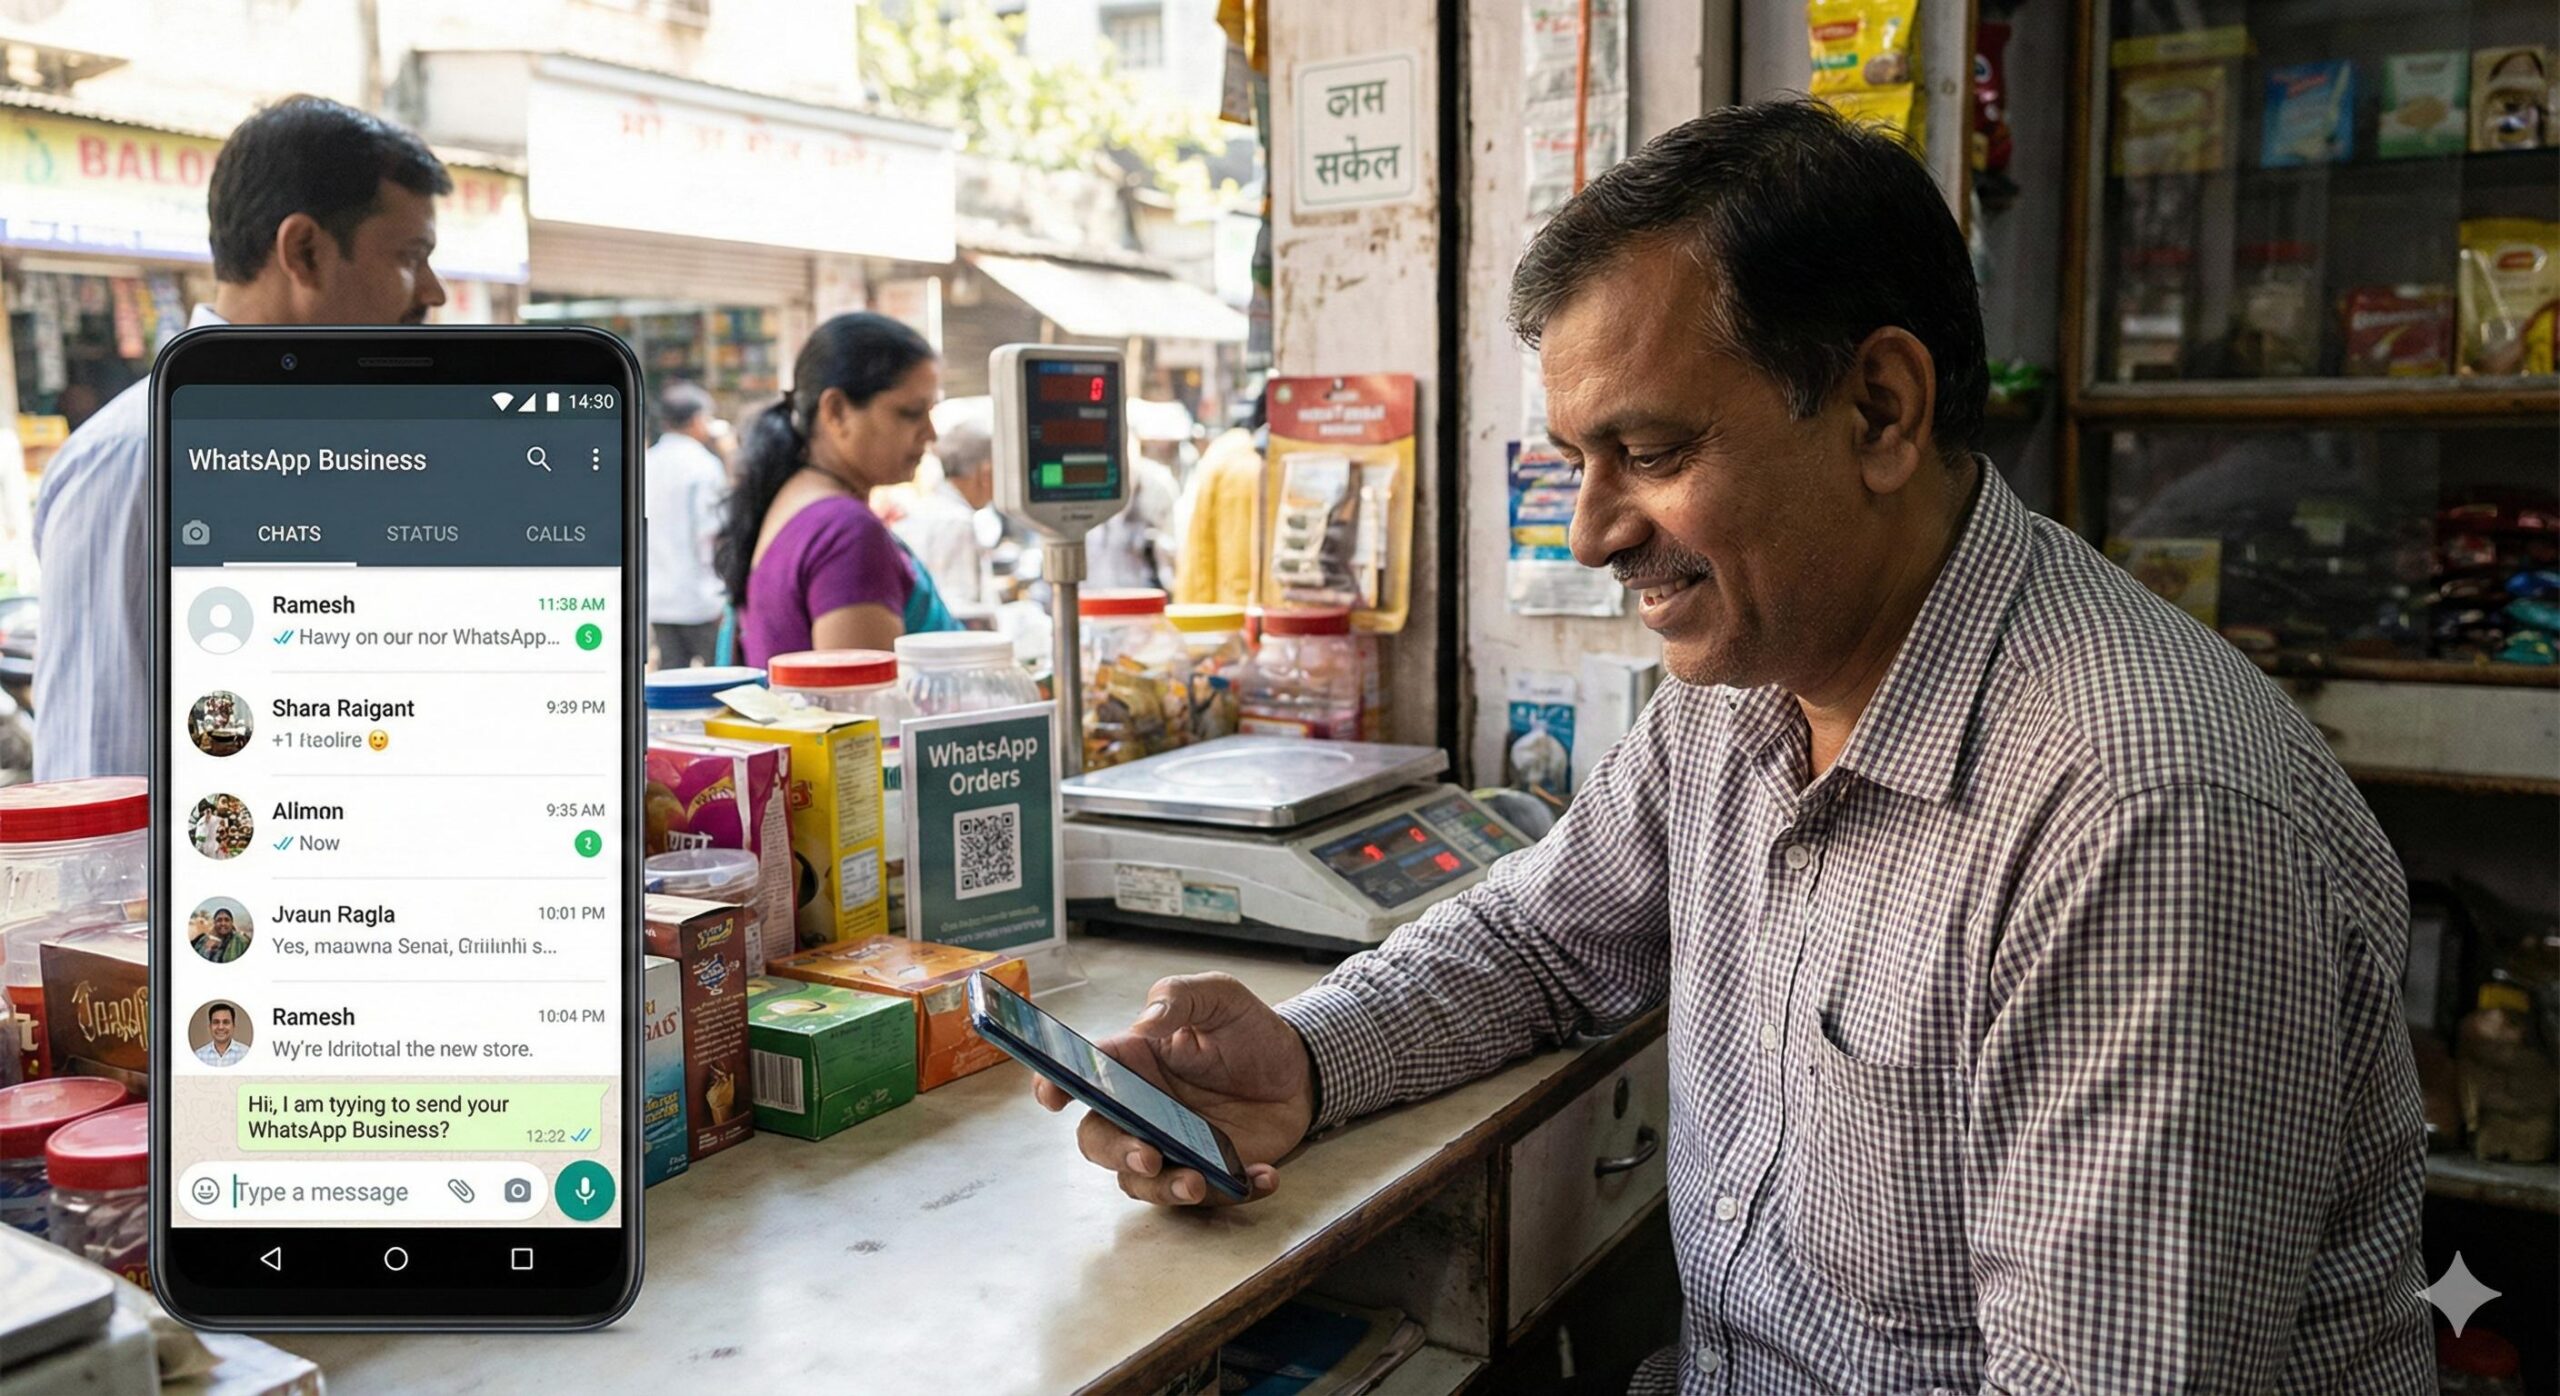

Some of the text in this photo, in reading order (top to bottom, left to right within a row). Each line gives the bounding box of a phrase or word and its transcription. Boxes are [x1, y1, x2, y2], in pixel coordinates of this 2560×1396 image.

[569, 394, 613, 409] 14:30
[189, 448, 426, 475] WhatsApp Business
[259, 526, 321, 541] CHATS
[387, 526, 458, 541] STATUS
[527, 526, 585, 541] CALLS
[273, 595, 354, 613] Ramesh
[539, 598, 604, 611] 11:38 AM
[300, 628, 559, 649] Hawy on our nor WhatsApp...
[273, 699, 414, 721] Shara Raigant
[547, 701, 605, 714] 9:39 PM
[272, 732, 292, 747] +1
[929, 735, 1038, 769] WhatsApp
[949, 769, 1022, 797] Orders
[272, 802, 343, 819] Alimon
[547, 803, 605, 817] 9:35 AM
[300, 835, 340, 851] Now
[272, 905, 395, 927] Jvaun Ragla
[539, 907, 604, 920] 10:01 PM
[272, 938, 309, 956] Yes,
[532, 941, 556, 954] s...
[274, 1007, 354, 1025] Ramesh
[539, 1009, 604, 1022] 10:04 PM
[406, 1040, 435, 1057] the
[441, 1044, 477, 1057] new
[483, 1042, 533, 1057] store.
[284, 1096, 287, 1112] I
[295, 1099, 323, 1112] am
[329, 1095, 385, 1117] tyying
[391, 1097, 410, 1112] to
[416, 1095, 461, 1112] send
[468, 1099, 509, 1117] your
[249, 1120, 449, 1142] WhatsApp Business?
[527, 1129, 565, 1143] 12:22
[238, 1182, 408, 1206] Type a message
